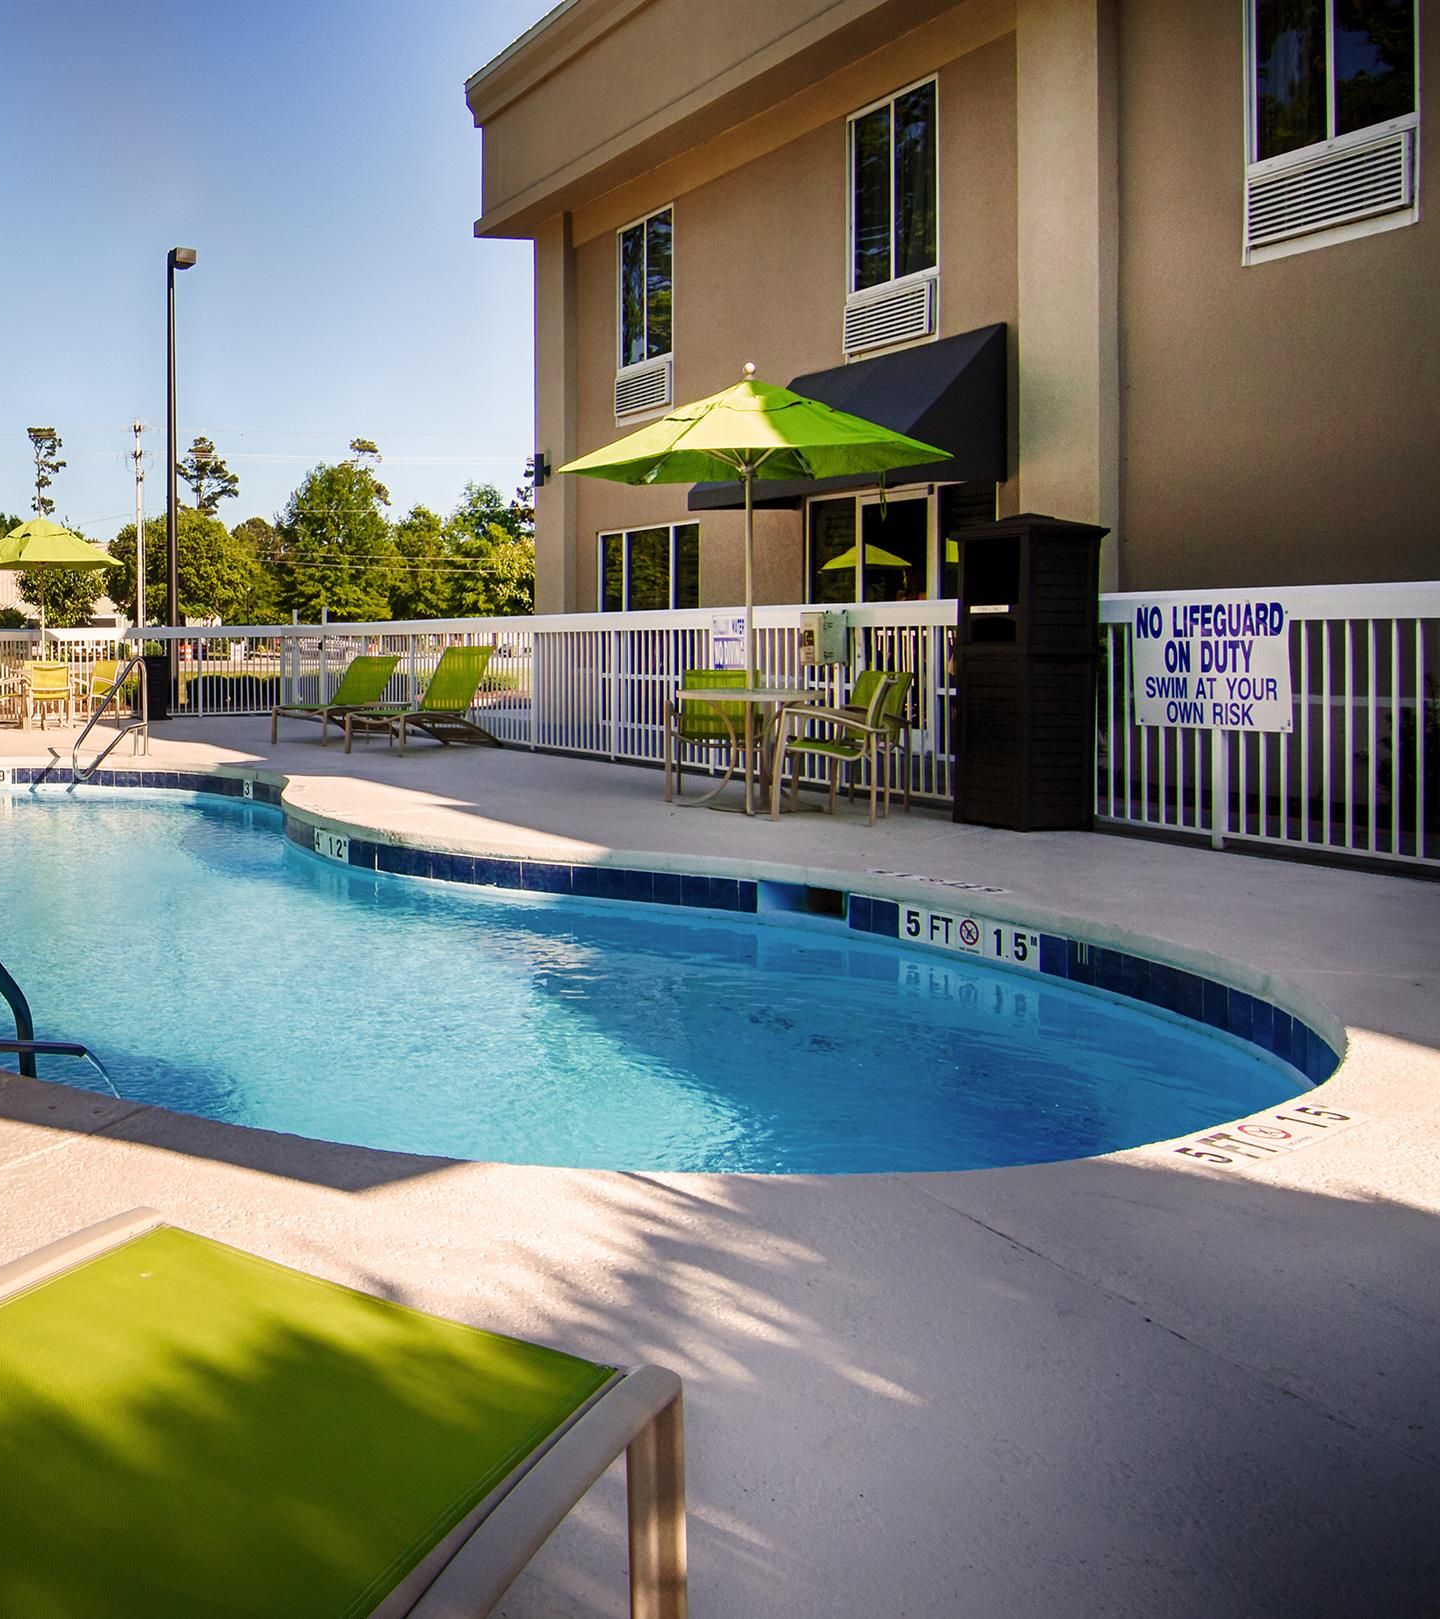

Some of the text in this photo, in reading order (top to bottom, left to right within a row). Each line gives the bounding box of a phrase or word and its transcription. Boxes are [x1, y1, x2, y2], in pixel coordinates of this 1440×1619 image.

[1136, 602, 1284, 639] NO LIFEGUARD
[1164, 639, 1253, 674] ON DUTY
[1145, 676, 1277, 701] SWIM AT YOUR
[1167, 701, 1254, 726] OWN RISK
[244, 782, 250, 795] 3
[315, 831, 320, 850] 4
[906, 909, 921, 937] 5
[930, 914, 953, 945] FT
[1174, 1147, 1233, 1164] 5
[1196, 1132, 1277, 1159] FT
